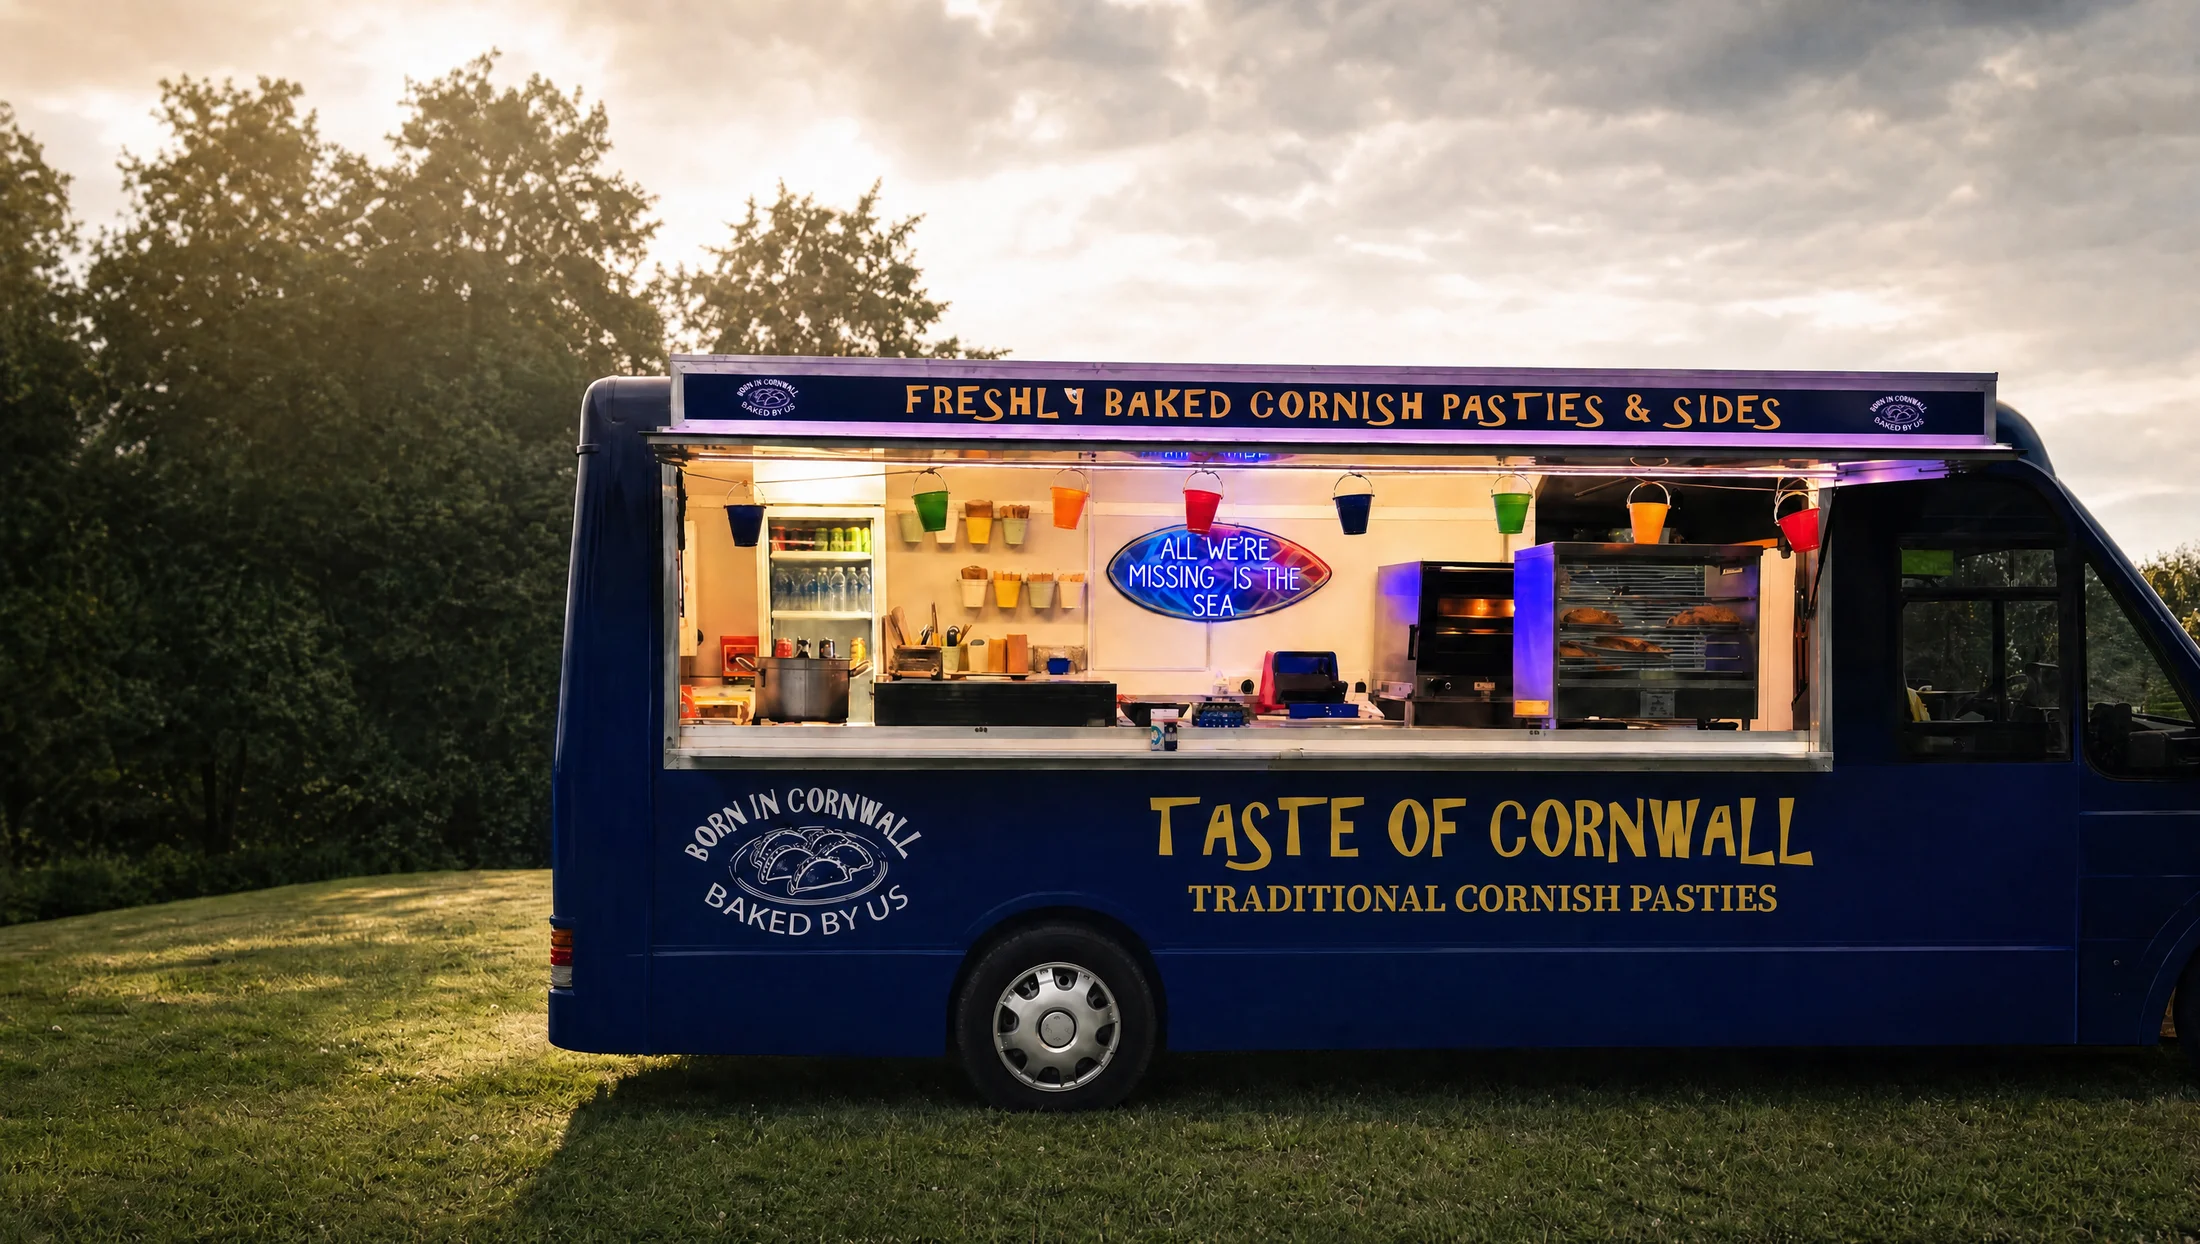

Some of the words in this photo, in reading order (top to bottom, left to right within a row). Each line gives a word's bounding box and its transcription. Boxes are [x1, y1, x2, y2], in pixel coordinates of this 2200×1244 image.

[741, 401, 770, 416] BAKED
[784, 403, 795, 413] US
[905, 385, 1085, 422] FRESHLY
[1104, 388, 1231, 418] BAKED
[1250, 390, 1423, 426] CORNISH
[1442, 392, 1604, 428] PASTIES
[1625, 393, 1651, 423] &
[1662, 395, 1781, 430] SIDES
[1874, 417, 1901, 431] BAKED
[1902, 423, 1913, 431] BY
[1914, 419, 1924, 427] US
[1160, 536, 1198, 561] ALL
[1206, 535, 1270, 561] WE'RE
[1129, 564, 1215, 589] MISSING
[1233, 566, 1252, 590] IS
[1262, 566, 1301, 591] THE
[1192, 594, 1235, 617] SEA
[684, 800, 749, 862] BORN
[749, 788, 781, 820] IN
[787, 787, 922, 860] CORNWALL
[1150, 796, 1365, 871] TASTE
[1387, 797, 1467, 858] OF
[1489, 797, 1814, 866] CORNWALL
[704, 882, 812, 936] BAKED
[820, 906, 858, 935] BY
[866, 884, 909, 922] US
[1188, 884, 1446, 913] TRADITIONAL
[1455, 884, 1621, 913] CORNISH
[1630, 884, 1778, 913] PASTIES
